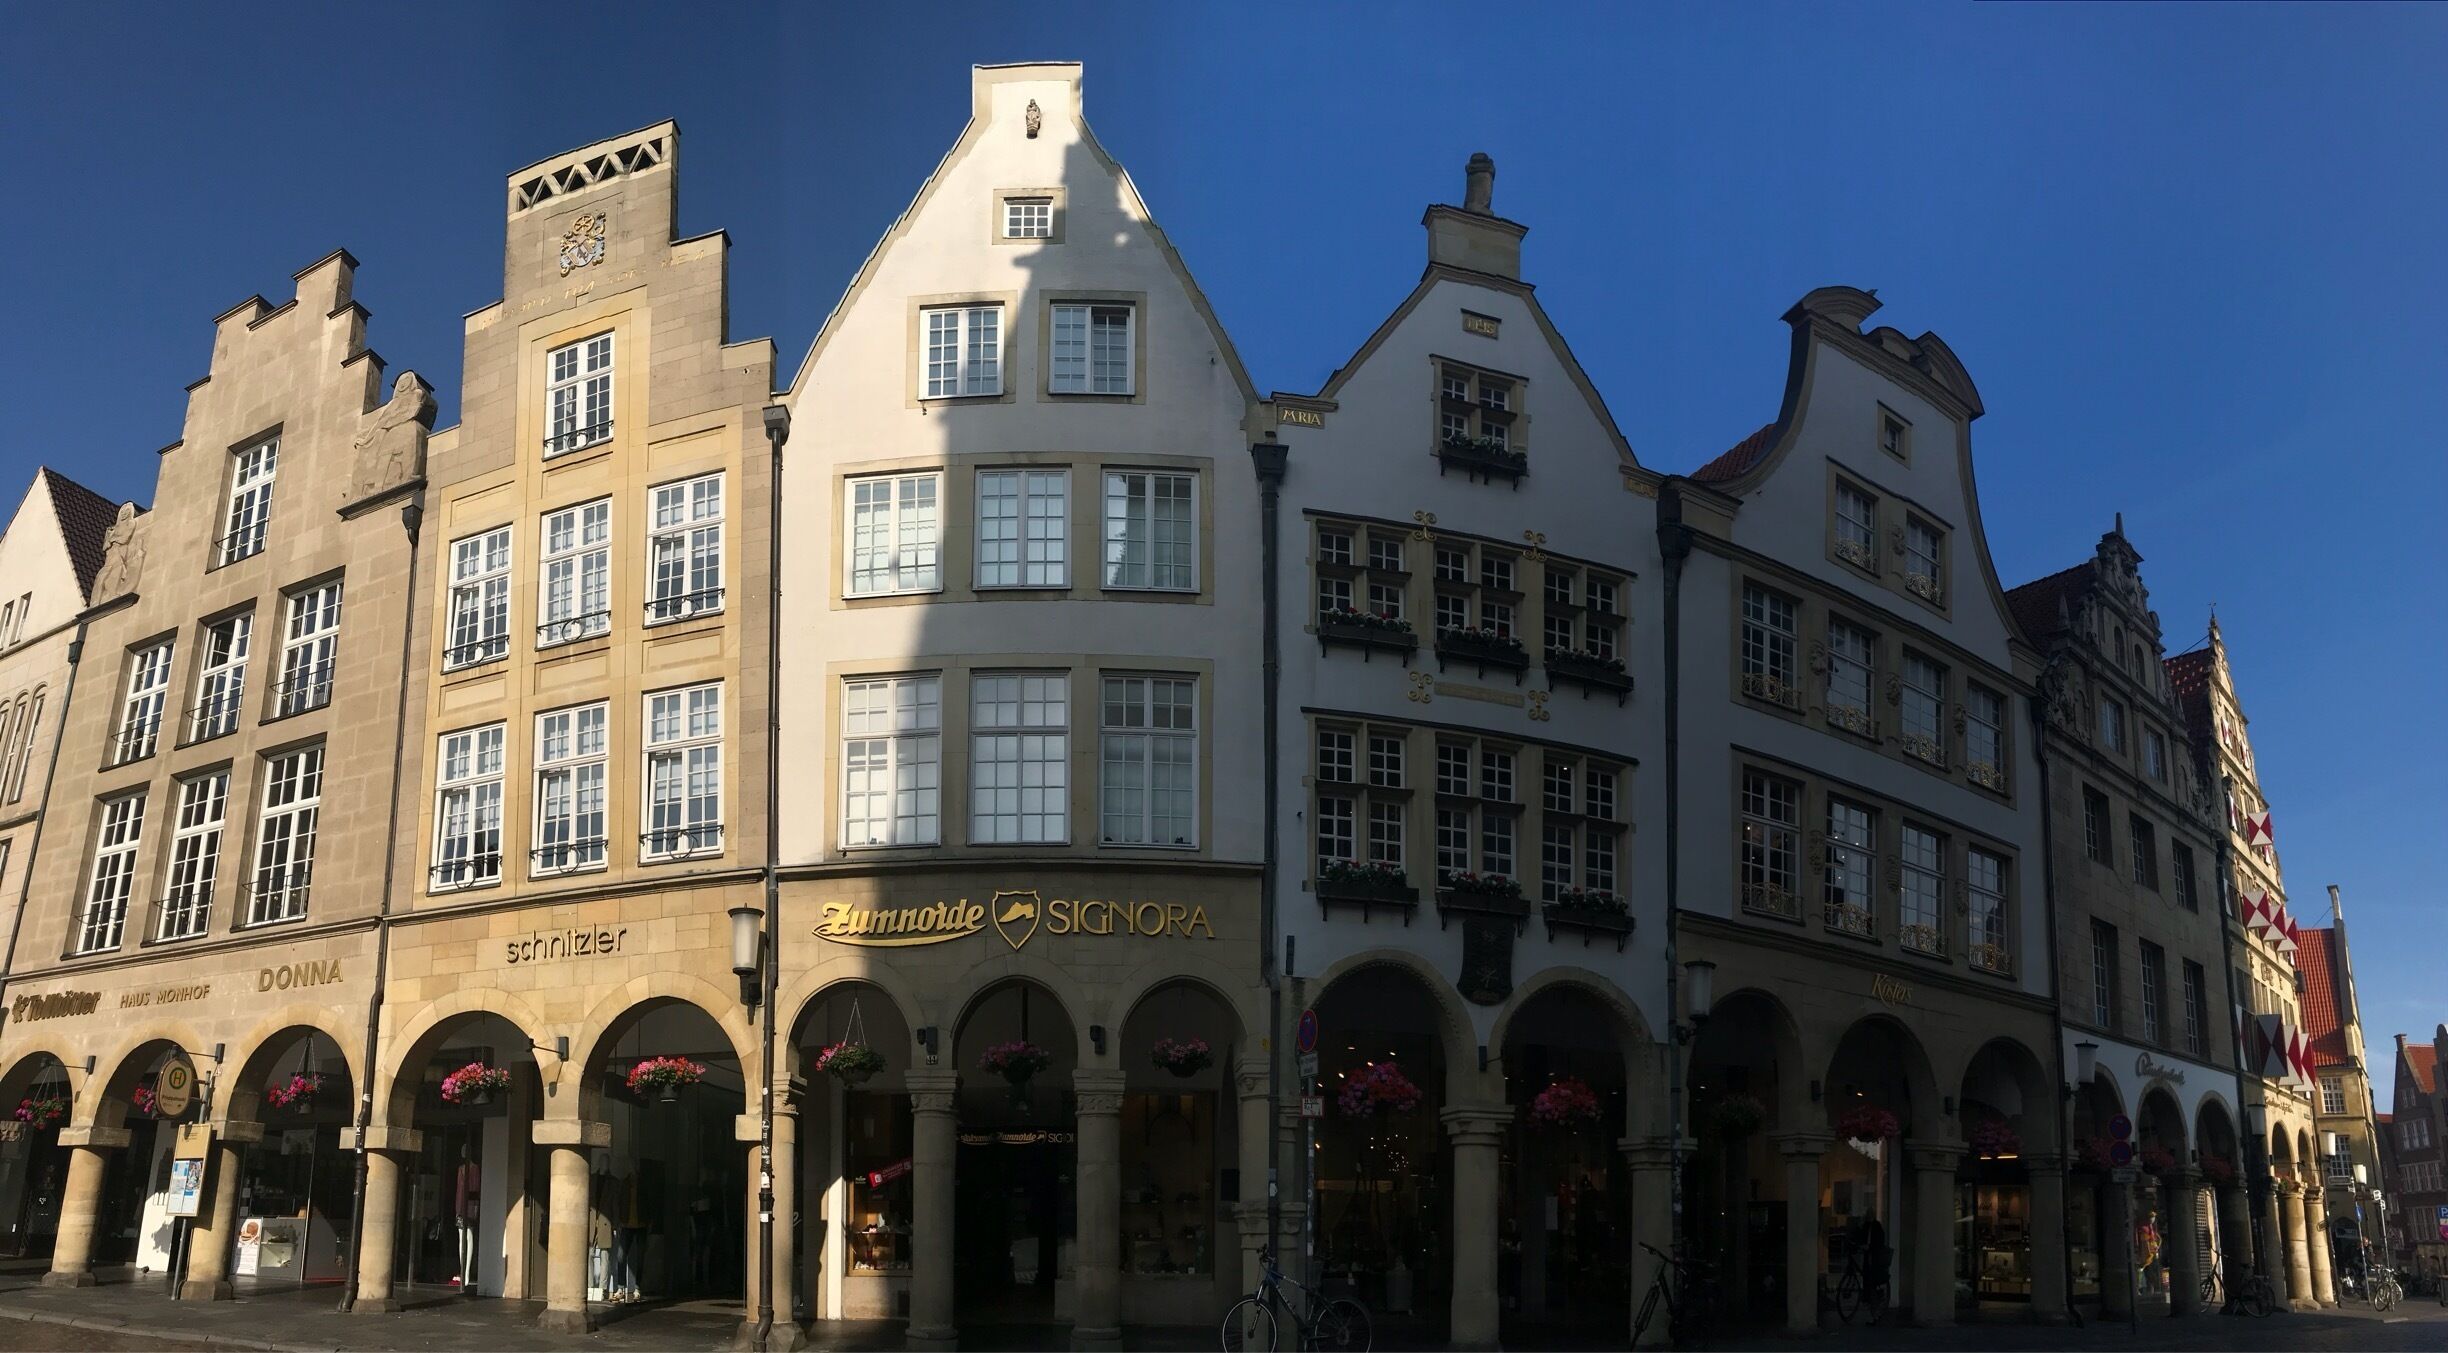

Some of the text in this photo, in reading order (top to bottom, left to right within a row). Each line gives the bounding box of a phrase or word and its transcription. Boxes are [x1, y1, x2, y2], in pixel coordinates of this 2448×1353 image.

[811, 898, 987, 943] Zumnorde
[1046, 899, 1216, 939] SIGNORA
[505, 922, 627, 963] schnitzler
[258, 957, 344, 993] DONNA
[120, 985, 211, 1009] HAUS MONHOF
